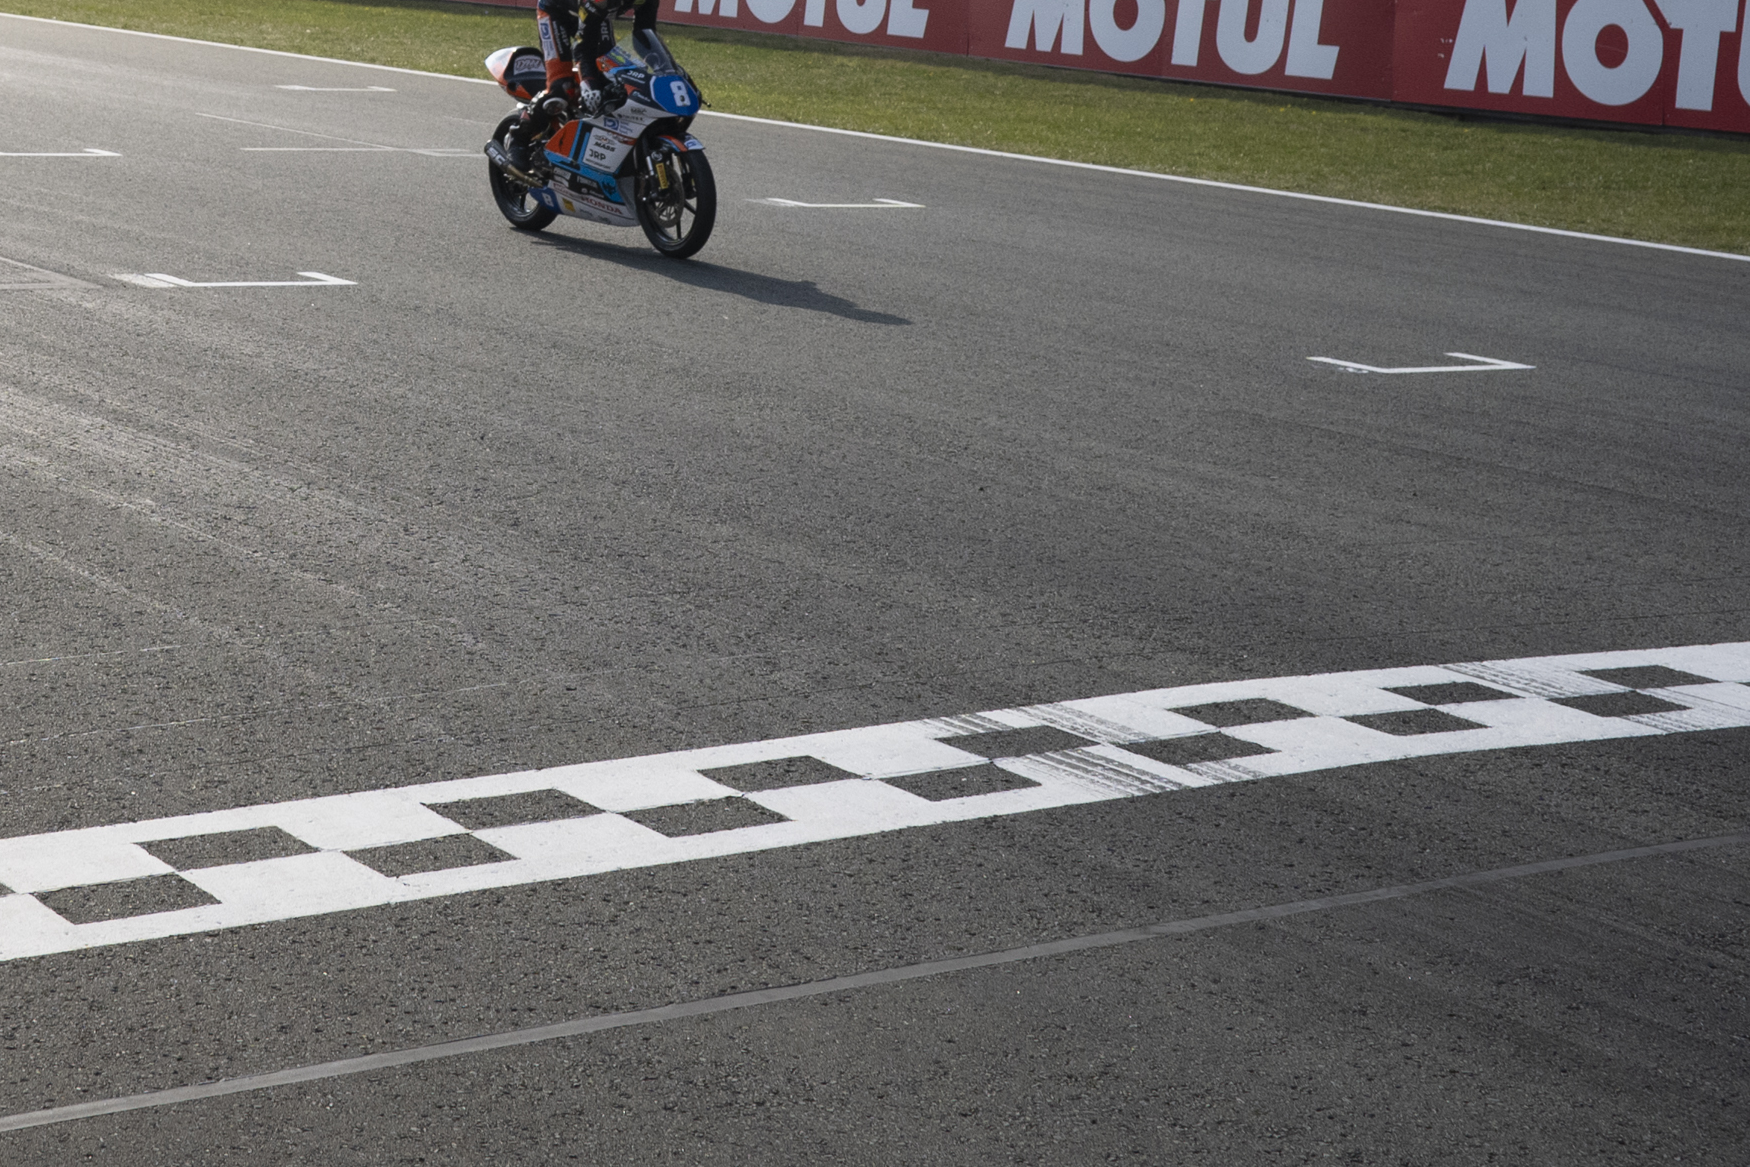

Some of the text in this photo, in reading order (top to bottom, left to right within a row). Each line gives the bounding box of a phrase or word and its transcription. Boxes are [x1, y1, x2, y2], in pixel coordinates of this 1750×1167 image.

[626, 69, 645, 80] JRP
[669, 80, 691, 108] 8
[593, 141, 616, 153] MASS
[589, 148, 607, 161] JRP
[581, 195, 623, 216] HONDA
